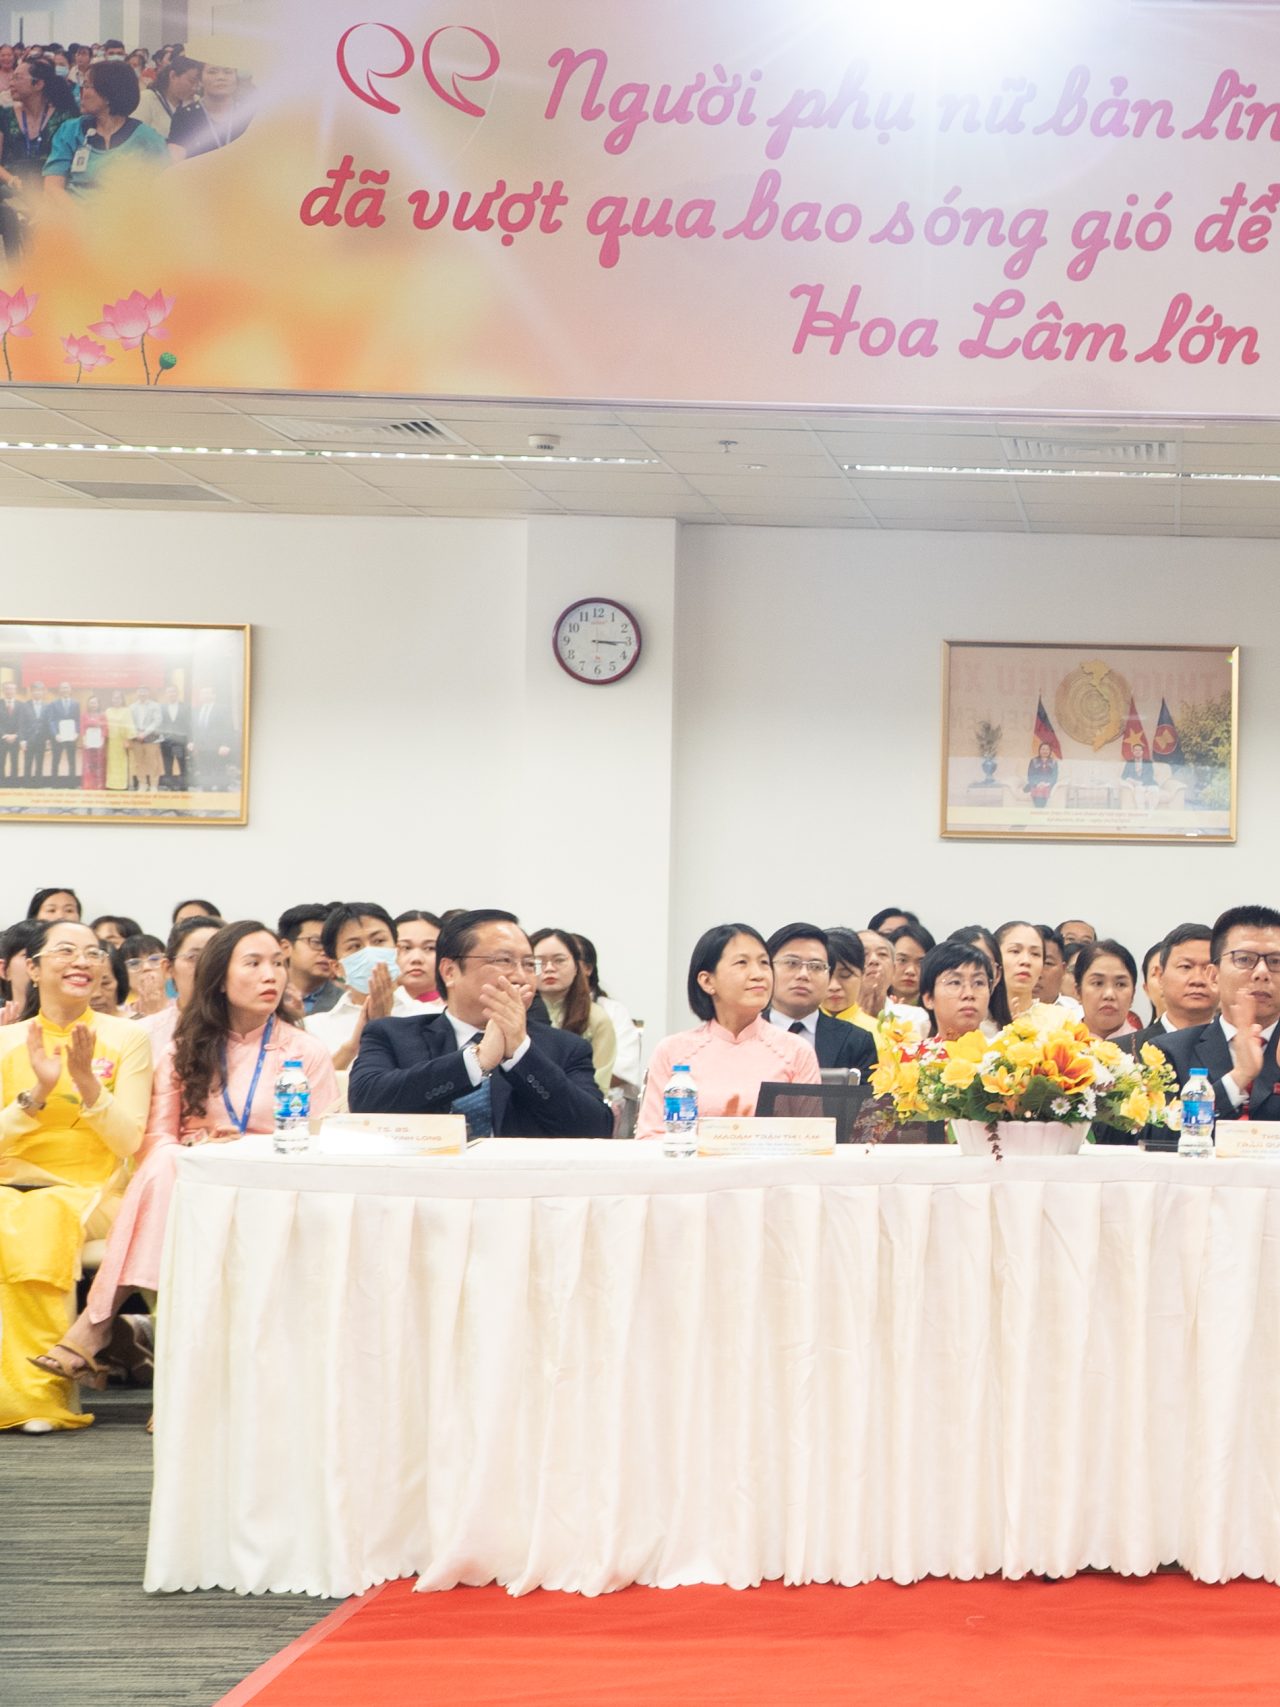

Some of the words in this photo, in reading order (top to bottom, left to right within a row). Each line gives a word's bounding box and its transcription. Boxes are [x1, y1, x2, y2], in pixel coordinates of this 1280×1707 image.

[544, 47, 763, 155] Người
[765, 56, 919, 160] phụ
[936, 58, 1030, 136] nữ
[1030, 64, 1175, 140] bản
[300, 154, 391, 228] đã
[406, 179, 569, 247] vượt
[586, 193, 716, 269] qua
[722, 168, 862, 243] bao
[868, 185, 1049, 280] sóng
[1067, 191, 1174, 282] gió
[790, 283, 939, 357] Hoa
[958, 289, 1128, 366] Lâm
[1135, 292, 1260, 366] lớn
[580, 611, 589, 622] 11
[592, 607, 605, 618] 12
[611, 611, 616, 622] 1
[568, 623, 580, 633] 10
[620, 624, 628, 633] 2
[563, 636, 571, 645] 9
[625, 636, 632, 647] 3
[567, 650, 575, 660] 8
[619, 650, 627, 660] 4
[578, 661, 586, 671] 7
[594, 664, 602, 675] 6
[609, 661, 616, 671] 5
